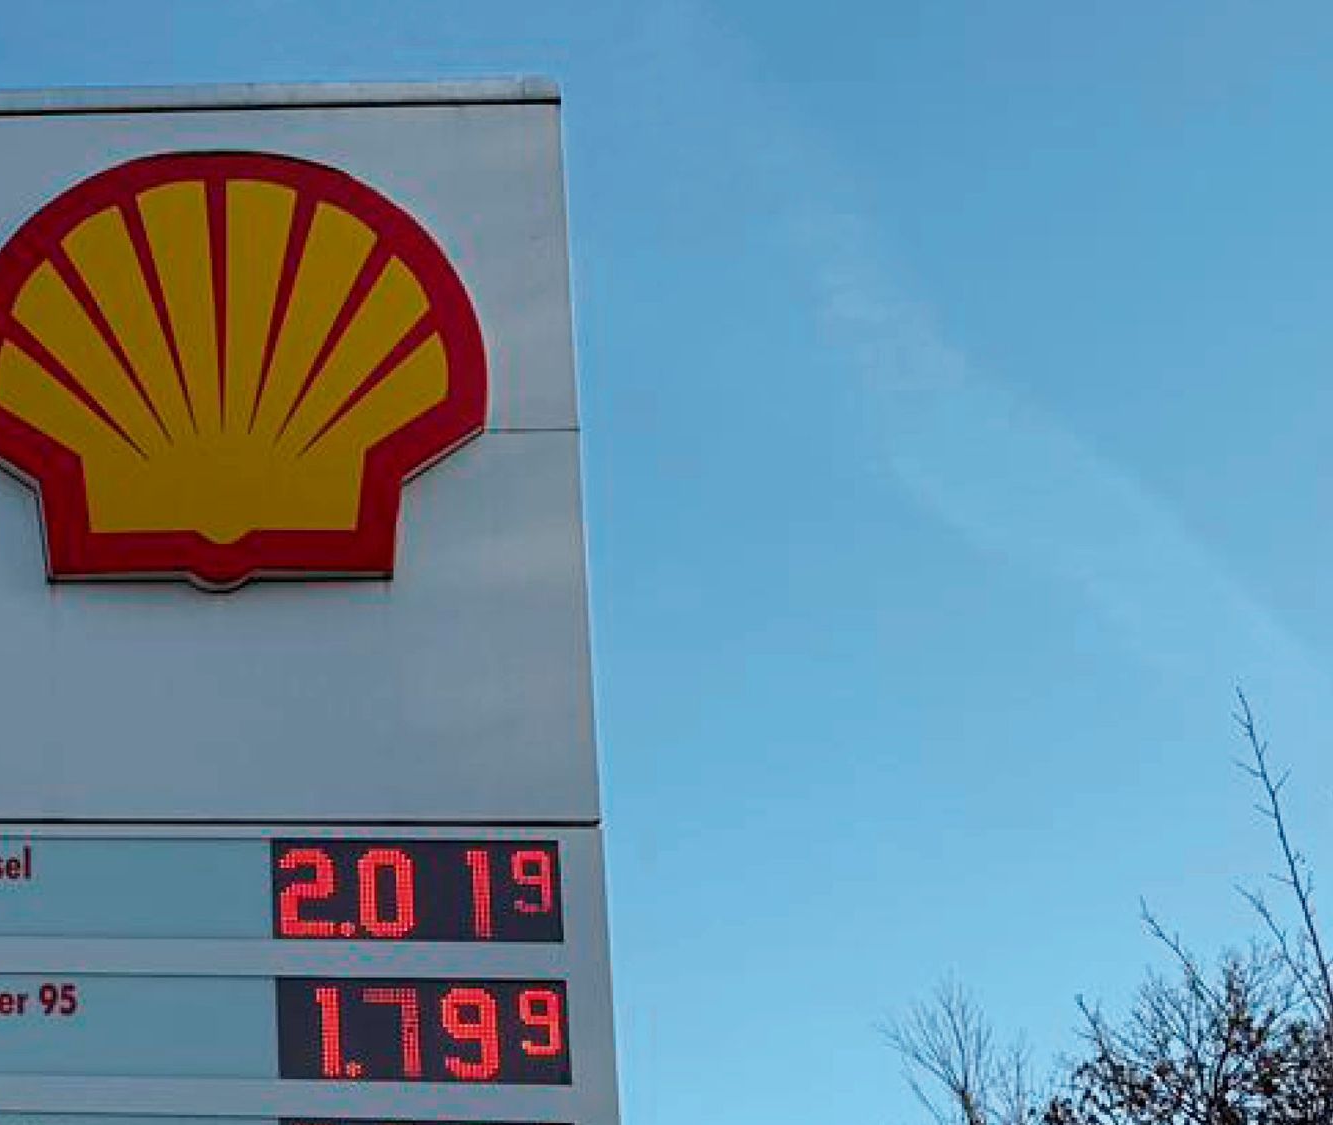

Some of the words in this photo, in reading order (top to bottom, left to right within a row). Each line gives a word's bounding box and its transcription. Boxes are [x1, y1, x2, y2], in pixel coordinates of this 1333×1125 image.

[278, 849, 552, 938] 2.019
[39, 984, 78, 1017] 95
[313, 986, 564, 1080] 1.799
